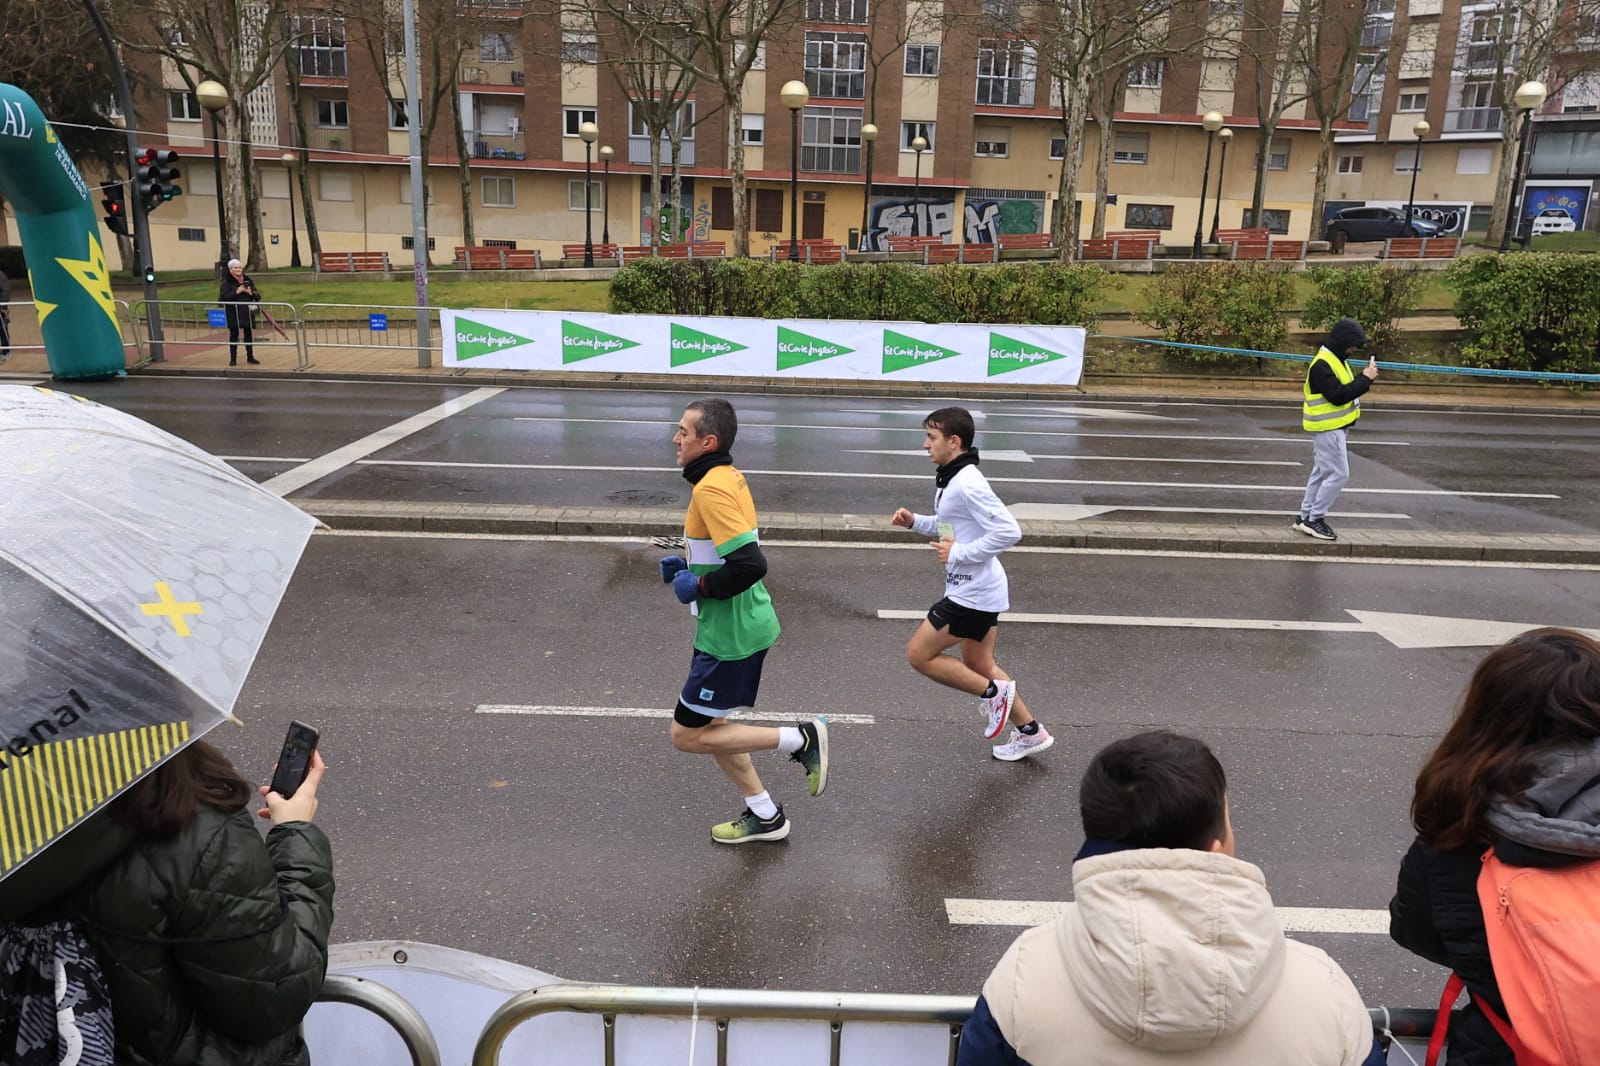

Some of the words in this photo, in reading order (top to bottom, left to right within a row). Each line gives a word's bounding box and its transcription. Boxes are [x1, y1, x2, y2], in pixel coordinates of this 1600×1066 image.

[456, 332, 466, 343] El
[466, 333, 487, 344] Corte
[563, 336, 573, 346] El
[573, 337, 594, 347] Corte
[671, 339, 681, 349] El
[681, 340, 701, 350] Corte
[778, 342, 788, 353] El
[788, 343, 808, 354] Corte
[884, 345, 893, 356] El
[893, 346, 914, 357] Corte
[990, 348, 999, 359] El
[999, 349, 1020, 360] Corte
